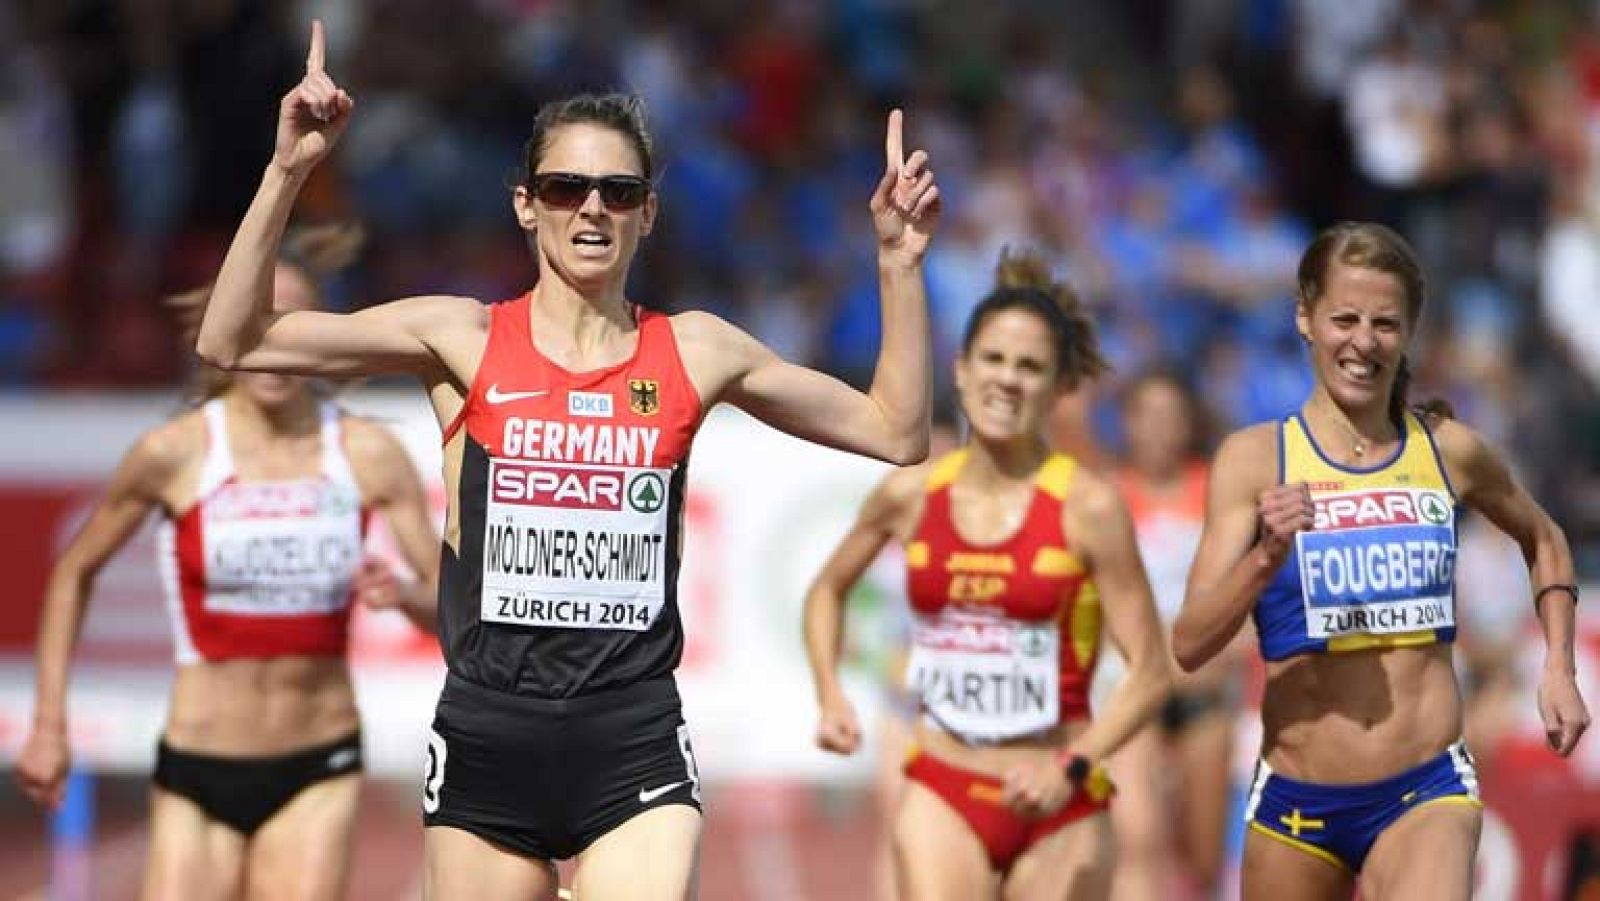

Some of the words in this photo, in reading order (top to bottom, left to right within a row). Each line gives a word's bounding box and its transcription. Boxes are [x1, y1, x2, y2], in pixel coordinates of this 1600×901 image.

[571, 394, 610, 413] DKB
[503, 417, 660, 466] GERMANY
[495, 469, 621, 506] SPAR
[488, 517, 662, 582] MÖLDNER-SCHMIDT
[1304, 541, 1452, 597] FOUGBERG
[497, 592, 590, 622] ZÜRICH
[599, 602, 649, 625] 2014
[1321, 606, 1407, 633] ZÜRICH
